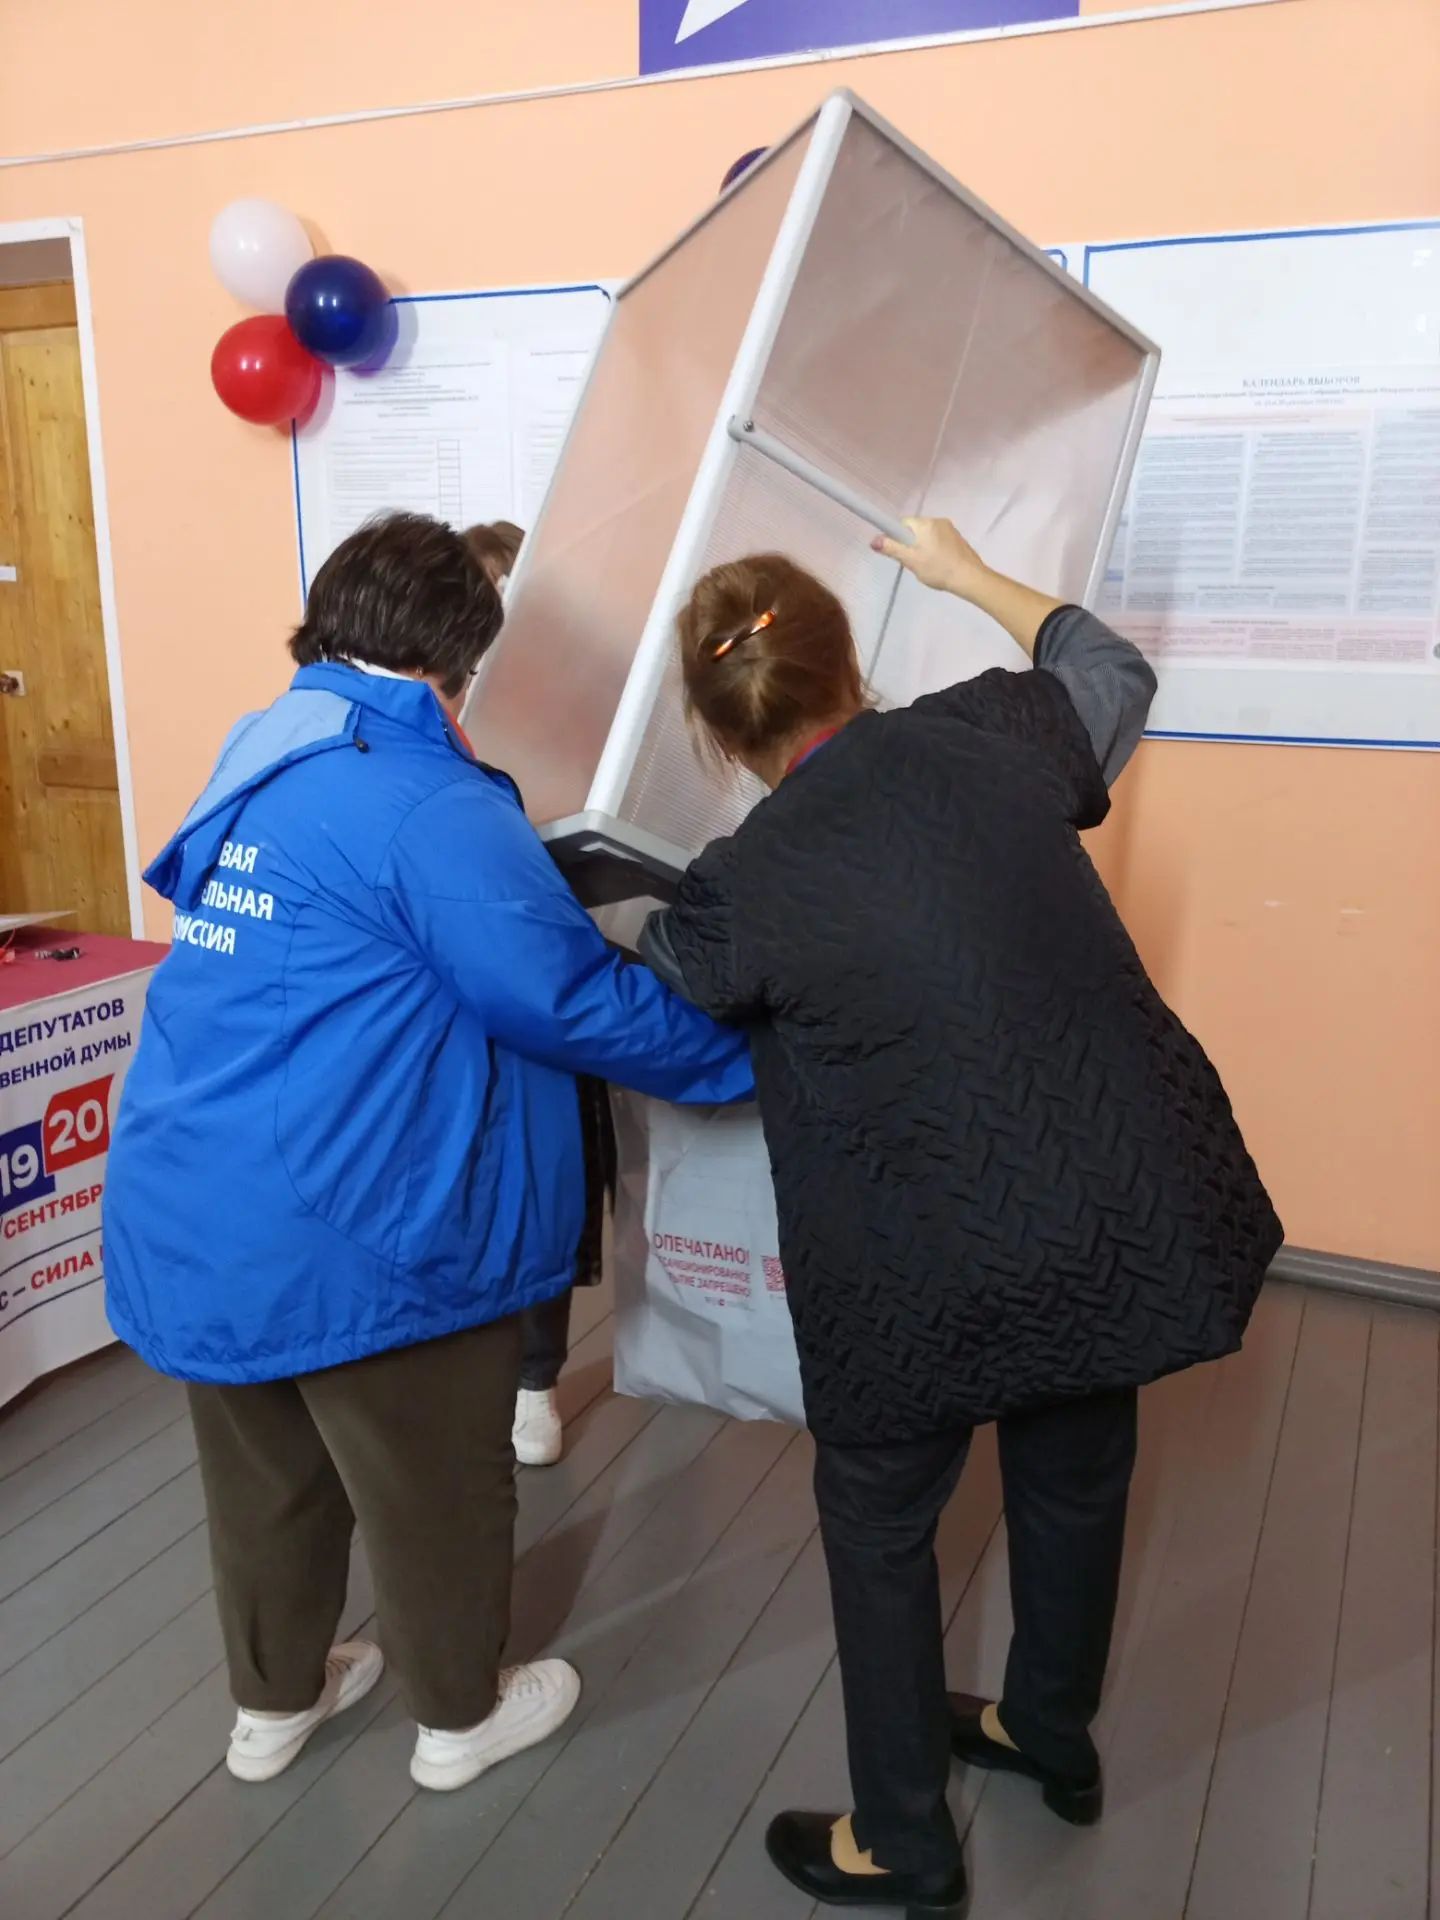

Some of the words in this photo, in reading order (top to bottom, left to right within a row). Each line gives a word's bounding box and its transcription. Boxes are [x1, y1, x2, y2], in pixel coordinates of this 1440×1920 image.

[218, 841, 258, 873] ВАЯ
[0, 998, 125, 1055] ДЕПУТАТОВ
[0, 1046, 76, 1090] ВЕННОЙ
[80, 1031, 131, 1065] ДУМЫ
[0, 1143, 39, 1197] 19
[48, 1098, 104, 1155] 20
[3, 1183, 103, 1240] СЕНТЯБР
[30, 1250, 95, 1290] СИЛА
